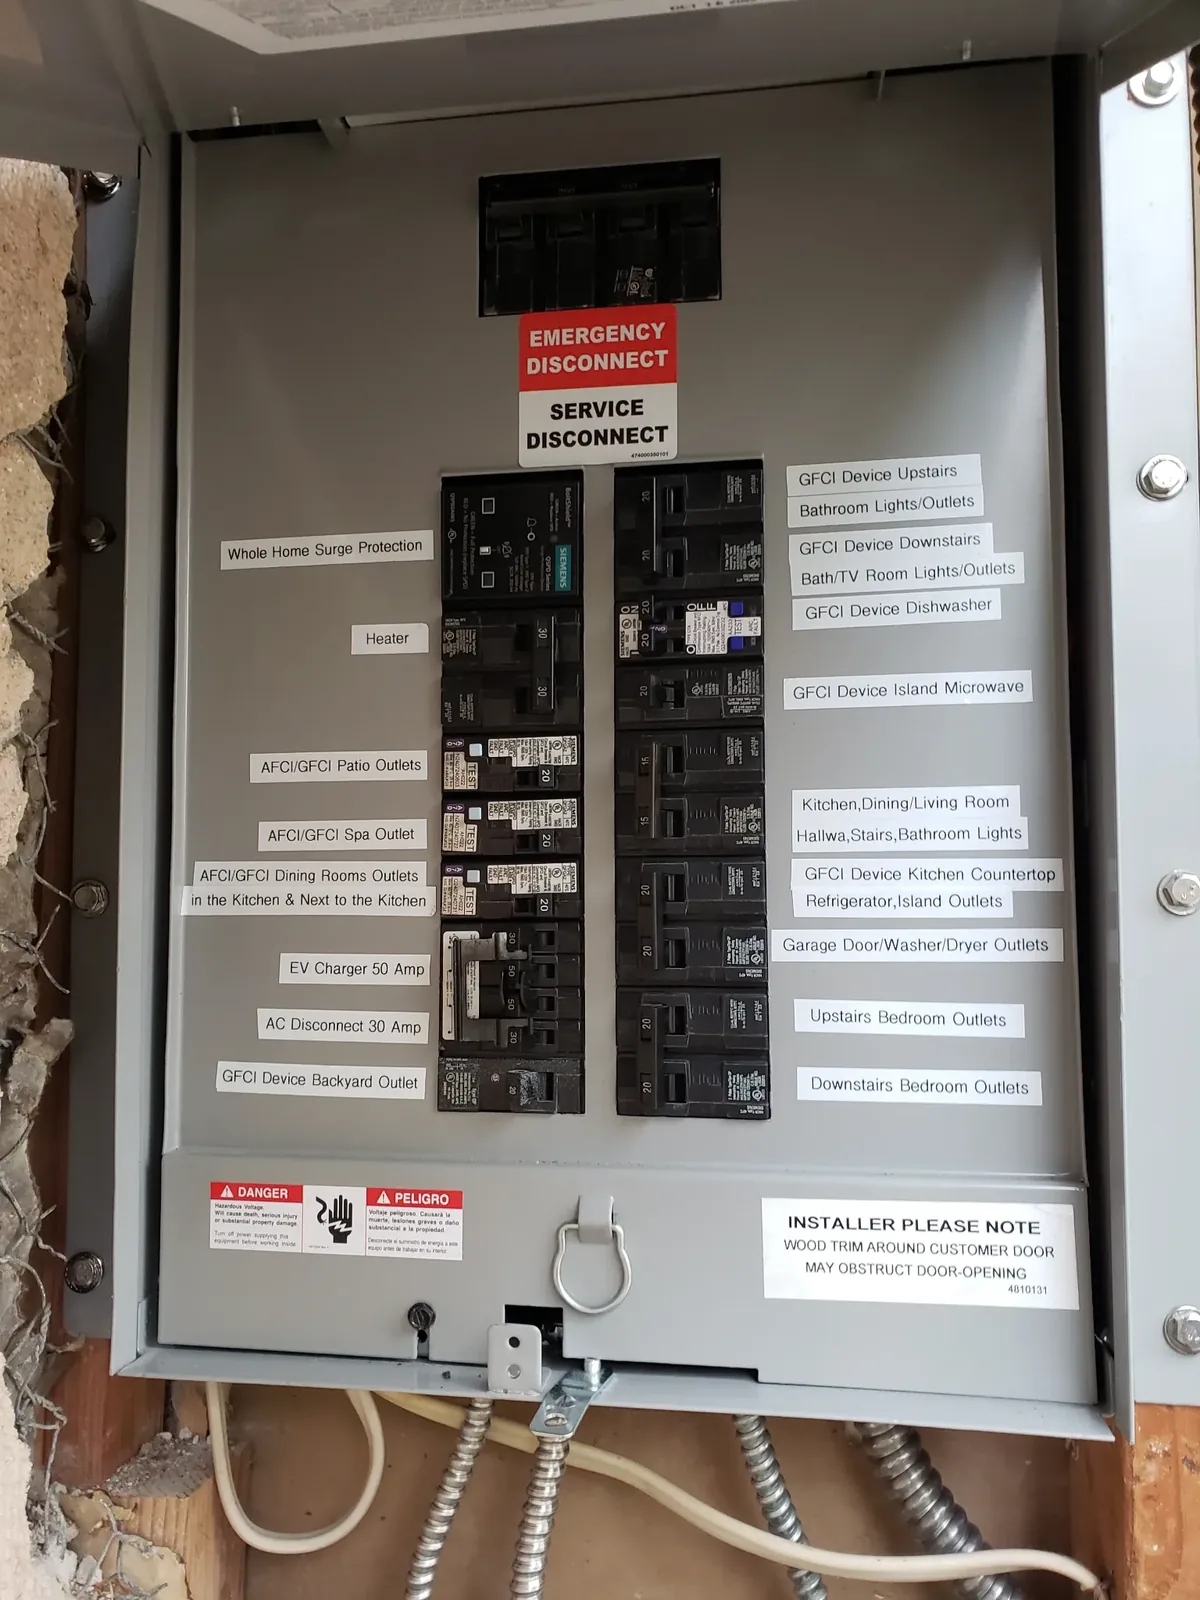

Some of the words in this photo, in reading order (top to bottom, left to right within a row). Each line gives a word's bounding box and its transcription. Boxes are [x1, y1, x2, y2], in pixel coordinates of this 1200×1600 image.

[530, 322, 665, 347] EMERGENCY
[527, 350, 668, 374] DISCONNECT
[551, 399, 644, 420] SERVICE
[527, 426, 668, 449] DISCONNECT
[799, 472, 835, 486] GFCI
[843, 469, 891, 484] Device
[898, 465, 958, 480] Upstairs
[642, 491, 650, 502] 20
[800, 502, 868, 518] Bathroom
[876, 496, 975, 514] Lights/Outlets
[228, 547, 268, 560] Whole
[272, 546, 310, 558] Home
[315, 543, 352, 557] Surge
[358, 539, 422, 554] Protection
[800, 541, 838, 556] GFCI
[845, 538, 893, 552] Device
[900, 533, 980, 550] Downstairs
[642, 550, 650, 560] 20
[560, 548, 568, 588] SIEMENS
[801, 570, 858, 586] Bath/TV
[866, 568, 908, 582] Room
[914, 562, 1016, 581] Lights/Outlets
[642, 600, 650, 614] 20
[805, 605, 844, 620] GFCI
[850, 602, 900, 617] Device
[906, 598, 992, 614] Dishwasher
[366, 632, 409, 644] Heater
[538, 628, 548, 638] 30
[641, 634, 649, 646] 20
[538, 686, 548, 697] 30
[640, 686, 648, 696] 20
[793, 686, 830, 700] GFCI
[838, 684, 888, 698] Device
[894, 681, 938, 696] Island
[944, 680, 1024, 694] Microwave
[261, 760, 331, 774] AFCI/GFCI
[338, 759, 370, 772] Patio
[376, 758, 422, 772] Outlets
[542, 770, 550, 782] 20
[802, 796, 958, 812] Kitchen,Dining/Living
[965, 795, 1010, 809] Room
[641, 816, 649, 825] 15
[268, 829, 338, 842] AFCI/GFCI
[344, 828, 370, 842] Spa
[375, 828, 414, 840] Outlet
[467, 826, 475, 851] TEST
[542, 834, 550, 848] 20
[796, 828, 970, 844] Hallwa,Stairs,Bathroom
[977, 826, 1022, 842] Lights
[200, 870, 269, 882] AFCI/GFCI
[276, 869, 315, 884] Dining
[322, 870, 366, 882] Rooms
[372, 870, 418, 882] Outlets
[805, 868, 844, 880] GFCI
[852, 868, 902, 880] Device
[908, 868, 964, 881] Kitchen
[971, 868, 1056, 884] Countertop
[641, 885, 650, 896] 20
[192, 894, 202, 906] in
[208, 894, 226, 906] the
[232, 894, 280, 906] Kitchen
[286, 894, 294, 906] &
[300, 894, 330, 906] Next
[335, 894, 346, 906] to
[352, 894, 372, 906] the
[378, 894, 426, 907] Kitchen
[466, 888, 475, 914] TEST
[540, 899, 549, 912] 20
[806, 894, 942, 910] Refrigerator,Island
[948, 894, 1003, 908] Outlets
[508, 933, 516, 944] 30
[783, 938, 836, 954] Garage
[843, 938, 988, 954] Door/Washer/Dryer
[994, 938, 1049, 952] Outlets
[643, 946, 652, 956] 20
[290, 962, 309, 974] EV
[315, 962, 367, 978] Charger
[372, 963, 388, 975] 50
[394, 964, 424, 978] Amp
[508, 966, 516, 977] 50
[508, 998, 515, 1010] 50
[266, 1017, 286, 1030] AC
[291, 1018, 363, 1032] Disconnect
[368, 1020, 384, 1032] 30
[391, 1021, 421, 1035] Amp
[642, 1018, 652, 1030] 20
[810, 1009, 871, 1026] Upstairs
[878, 1010, 946, 1025] Bedroom
[952, 1012, 1006, 1027] Outlets
[510, 1032, 518, 1044] 30
[222, 1069, 256, 1083] GFCI
[262, 1072, 306, 1086] Device
[312, 1074, 372, 1090] Backyard
[378, 1076, 418, 1089] Outlet
[642, 1082, 652, 1093] 20
[811, 1077, 893, 1092] Downstairs
[900, 1078, 968, 1094] Bedroom
[974, 1080, 1029, 1095] Outlets
[509, 1086, 516, 1094] 20
[238, 1188, 288, 1199] DANGER
[394, 1193, 449, 1205] PELIGRO
[788, 1216, 894, 1232] INSTALLER
[902, 1219, 979, 1233] PLEASE
[986, 1220, 1040, 1234] NOTE
[784, 1239, 826, 1252] WOOD
[831, 1240, 864, 1253] TRIM
[867, 1242, 926, 1254] AROUND
[930, 1244, 1008, 1256] CUSTOMER
[1013, 1245, 1054, 1258] DOOR
[806, 1262, 834, 1274] MAY
[838, 1263, 912, 1276] OBSTRUCT
[917, 1265, 1026, 1280] DOOR-OPENING
[1008, 1285, 1048, 1295] 4810131
